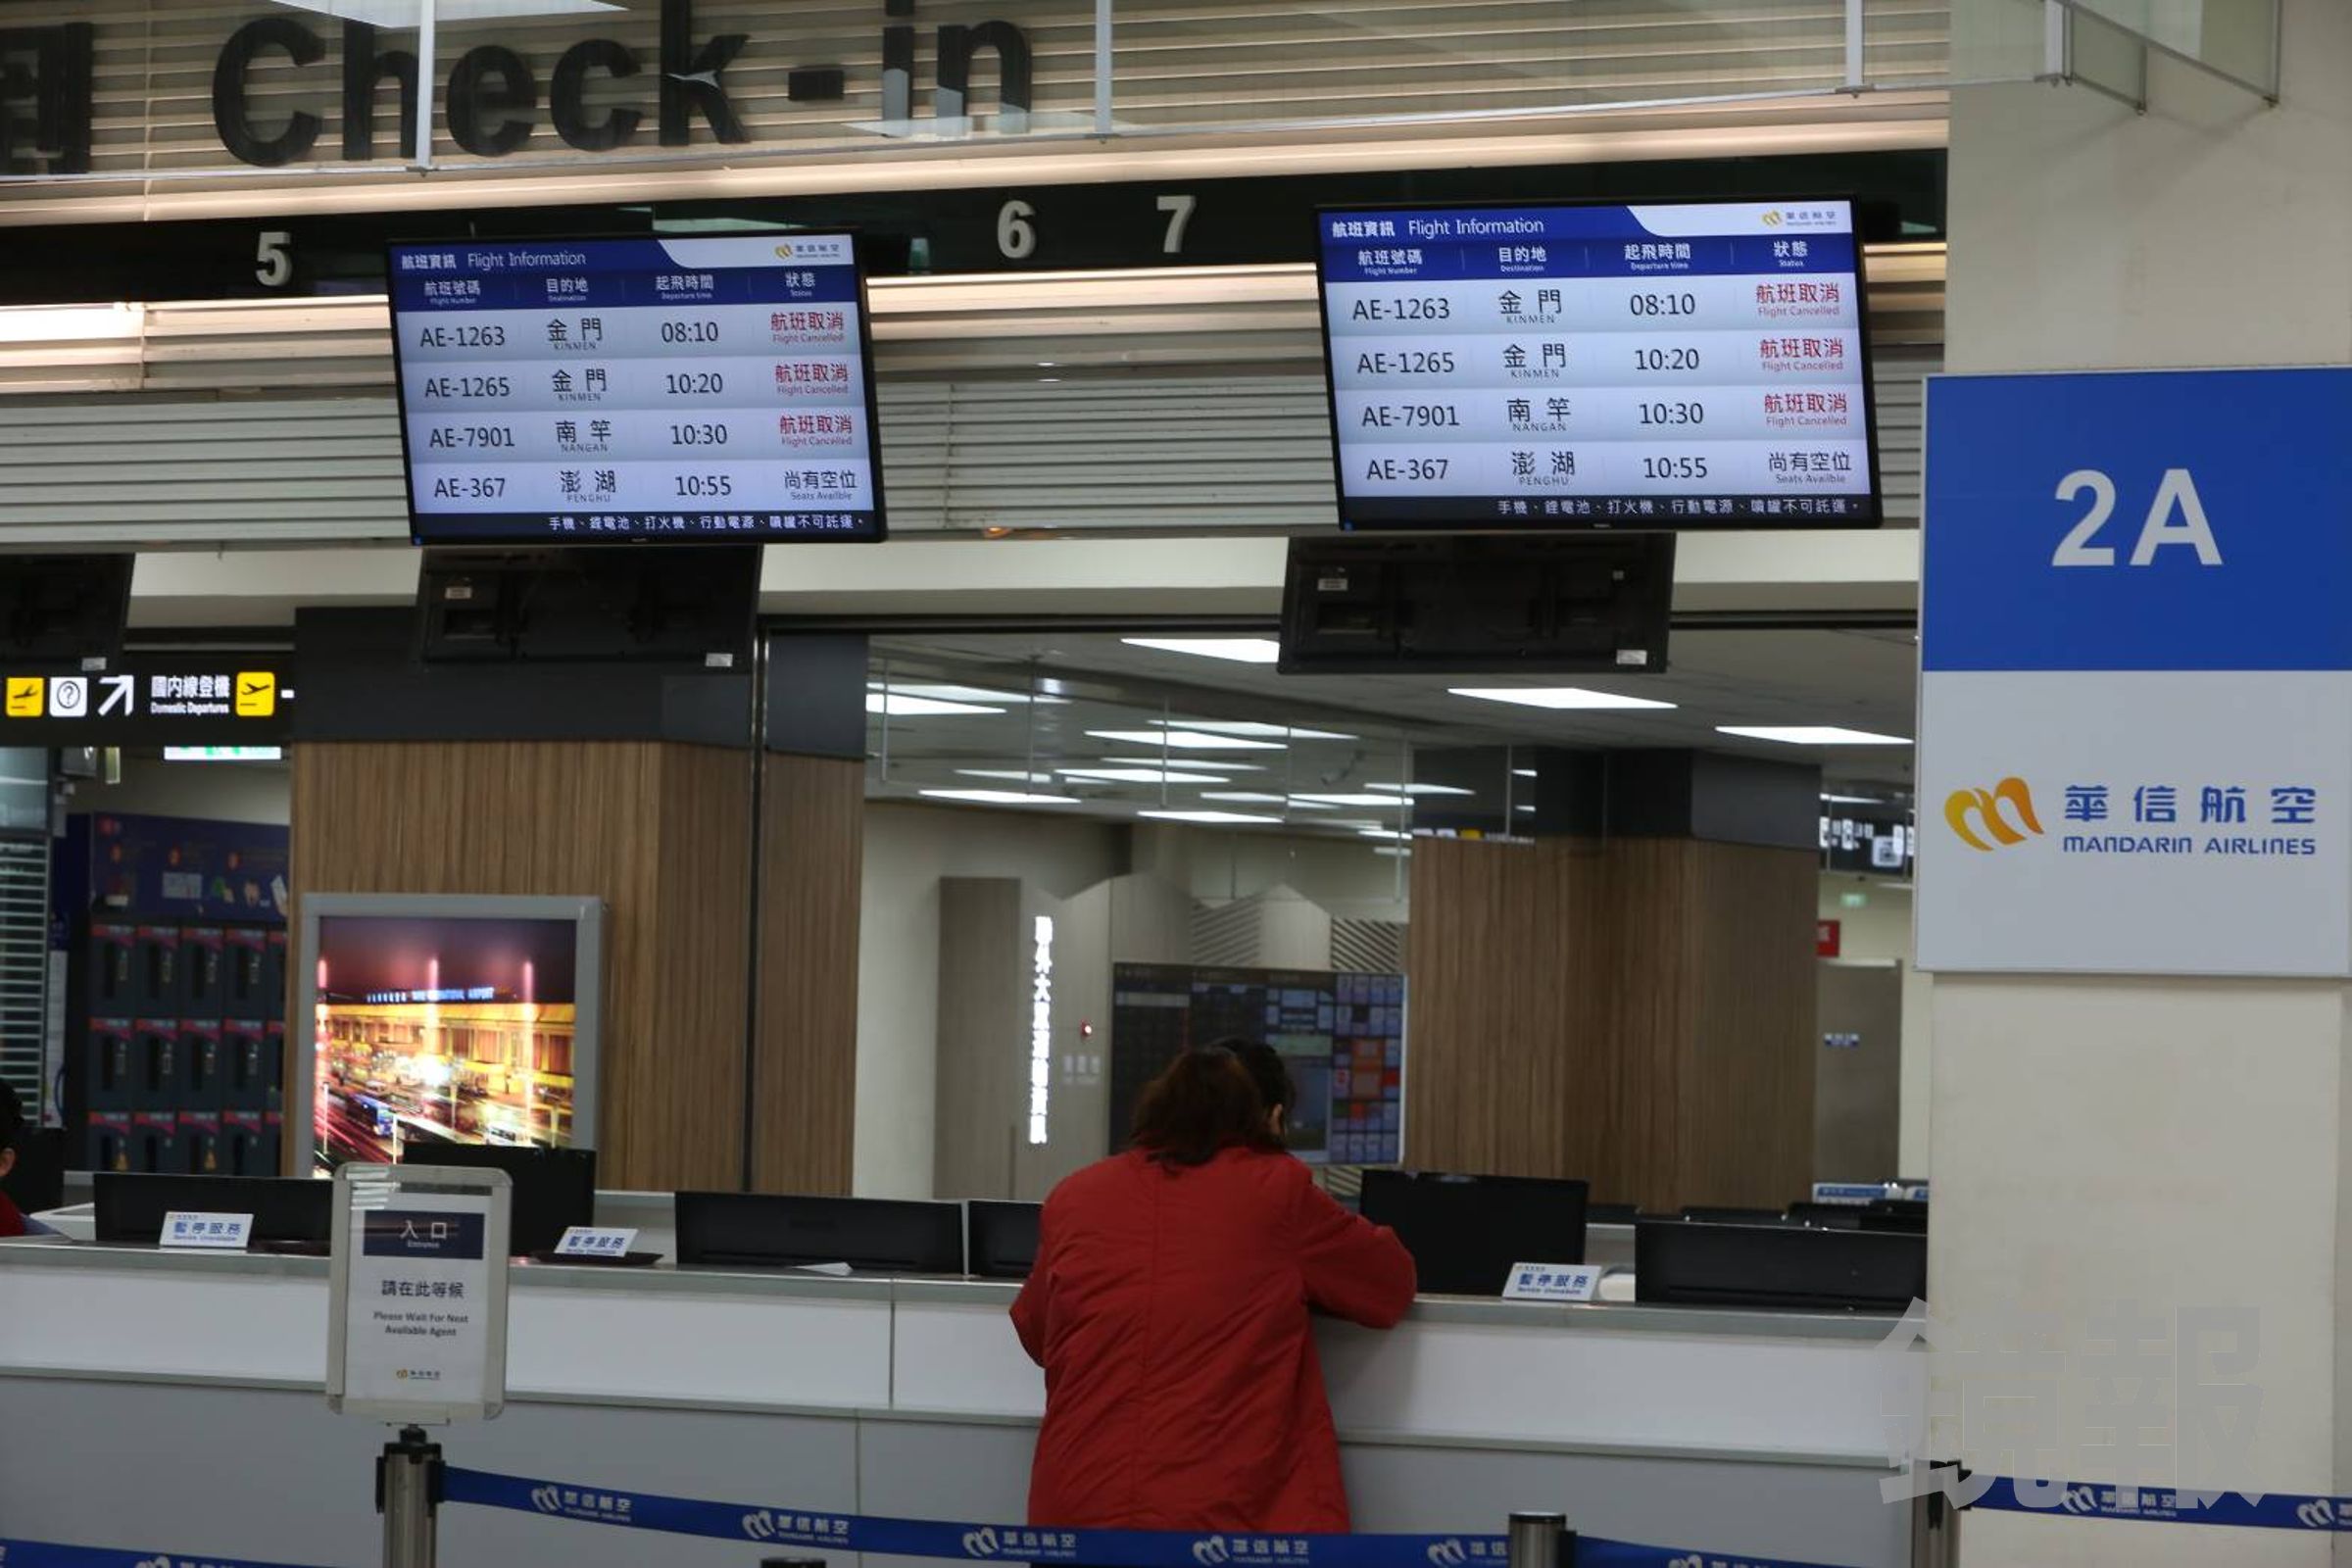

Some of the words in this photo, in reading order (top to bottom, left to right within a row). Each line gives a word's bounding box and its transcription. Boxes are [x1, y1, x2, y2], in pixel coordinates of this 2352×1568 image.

[998, 200, 1036, 259] 6
[1156, 195, 1197, 253] 7
[1408, 219, 1449, 240] Flight
[1456, 218, 1544, 234] Information
[256, 231, 292, 286] 5
[1499, 247, 1546, 263] 目的地
[1624, 243, 1690, 261] 起飛時間
[1773, 240, 1808, 258] 狀態
[467, 252, 503, 270] Flight
[510, 250, 586, 267] Information
[547, 278, 588, 294] 目的地
[655, 274, 714, 291] 起飛時間
[785, 271, 815, 288] 狀態
[1498, 289, 1562, 315] 金門
[1756, 282, 1839, 304] 航班取消
[1352, 298, 1449, 320] AE-1263
[1630, 293, 1695, 317] 08:10
[547, 318, 603, 342] 金門
[662, 321, 718, 343] 08:10
[770, 312, 844, 331] 航班取消
[419, 326, 506, 347] AE-1263
[1502, 343, 1566, 368] 金門
[1760, 337, 1843, 359] 航班取消
[1357, 352, 1454, 374] AE-1265
[1635, 348, 1699, 370] 10:20
[552, 368, 607, 393] 金門
[666, 373, 723, 394] 10:20
[775, 364, 849, 382] 航班取消
[424, 377, 510, 398] AE-1265
[1507, 397, 1571, 422] 南竿
[1639, 403, 1703, 424] 10:30
[1764, 393, 1847, 414] 航班取消
[780, 415, 853, 435] 航班取消
[1361, 405, 1460, 427] AE-7901
[429, 427, 515, 448] AE-7901
[555, 419, 612, 443] 南竿
[670, 424, 727, 445] 10:30
[1366, 459, 1448, 481] AE-367
[1512, 451, 1576, 476] 澎湖
[1643, 457, 1708, 479] 10:55
[1768, 452, 1851, 472] 尚有空位
[434, 477, 506, 498] AE-367
[560, 469, 616, 493] 澎湖
[674, 475, 732, 496] 10:55
[784, 469, 858, 489] 尚有空位
[2052, 468, 2224, 566] 2A
[2064, 785, 2317, 823] 華信航空
[2064, 836, 2192, 855] MANDARIN
[2205, 837, 2316, 856] AIRLINES
[400, 1220, 447, 1240] 入口
